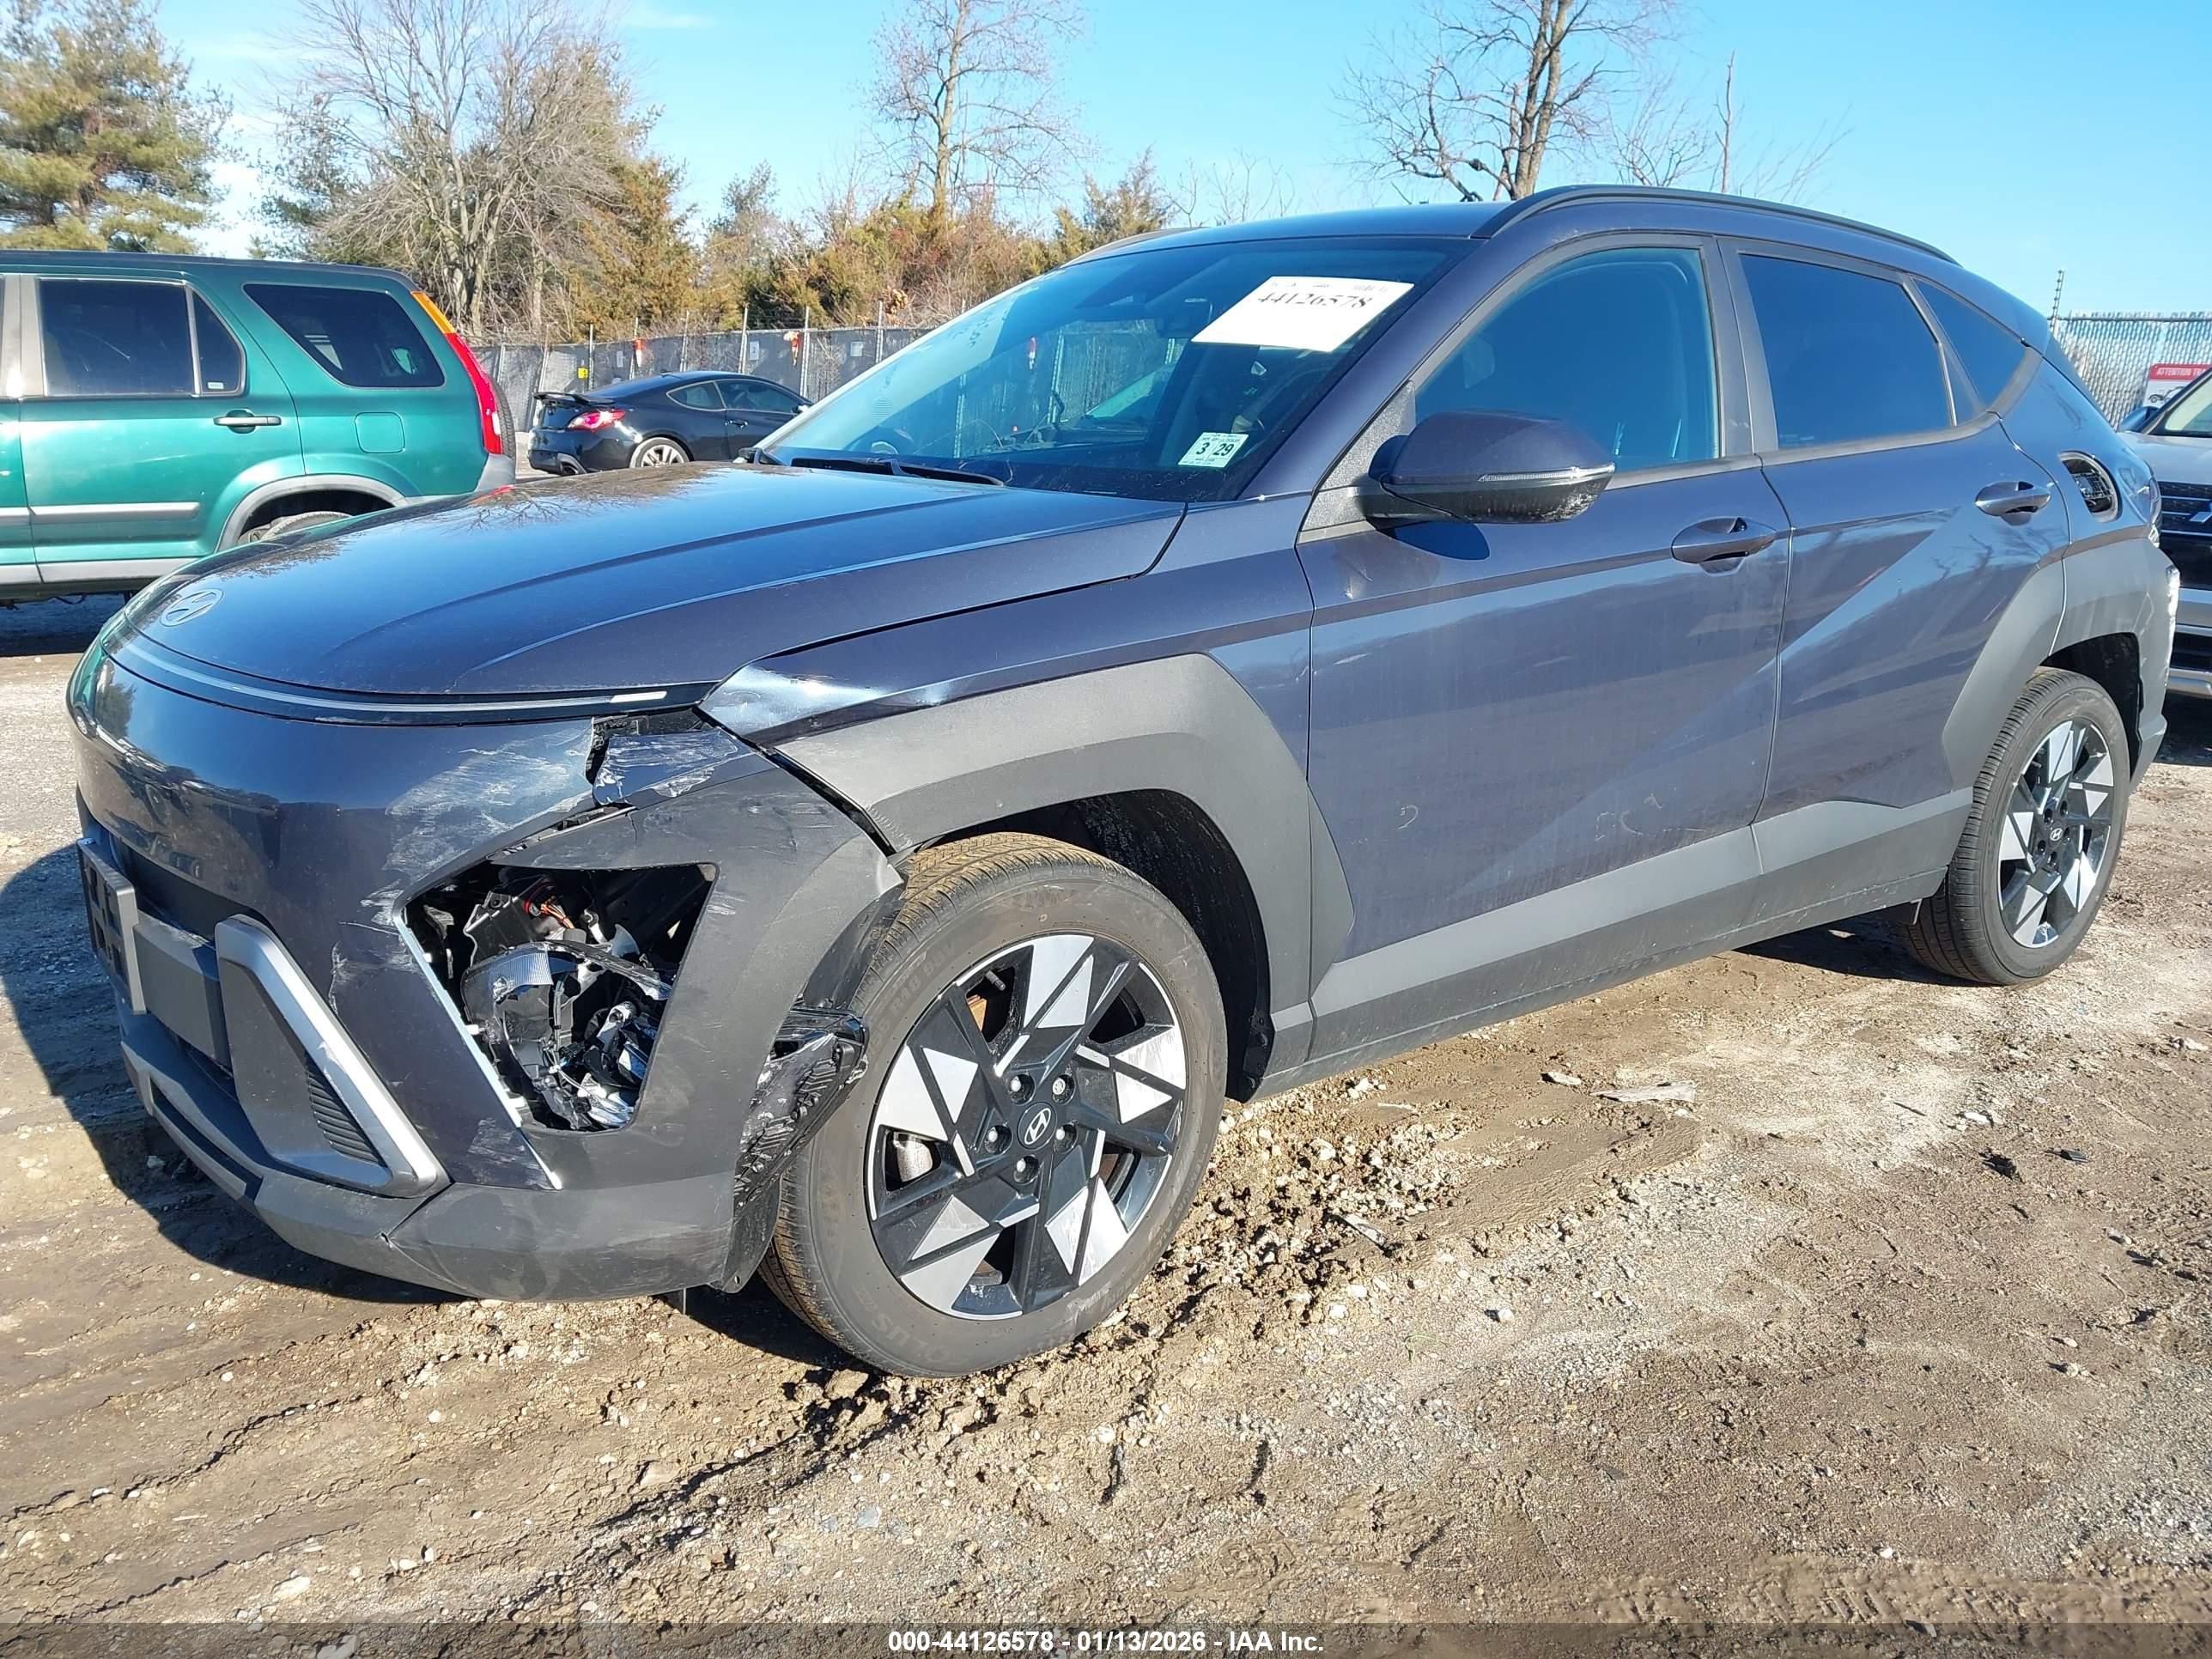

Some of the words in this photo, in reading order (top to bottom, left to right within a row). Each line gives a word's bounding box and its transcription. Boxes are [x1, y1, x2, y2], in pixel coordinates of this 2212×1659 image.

[1257, 292, 1372, 308] 44126578
[1196, 442, 1210, 455] 3
[1212, 443, 1234, 456] 29
